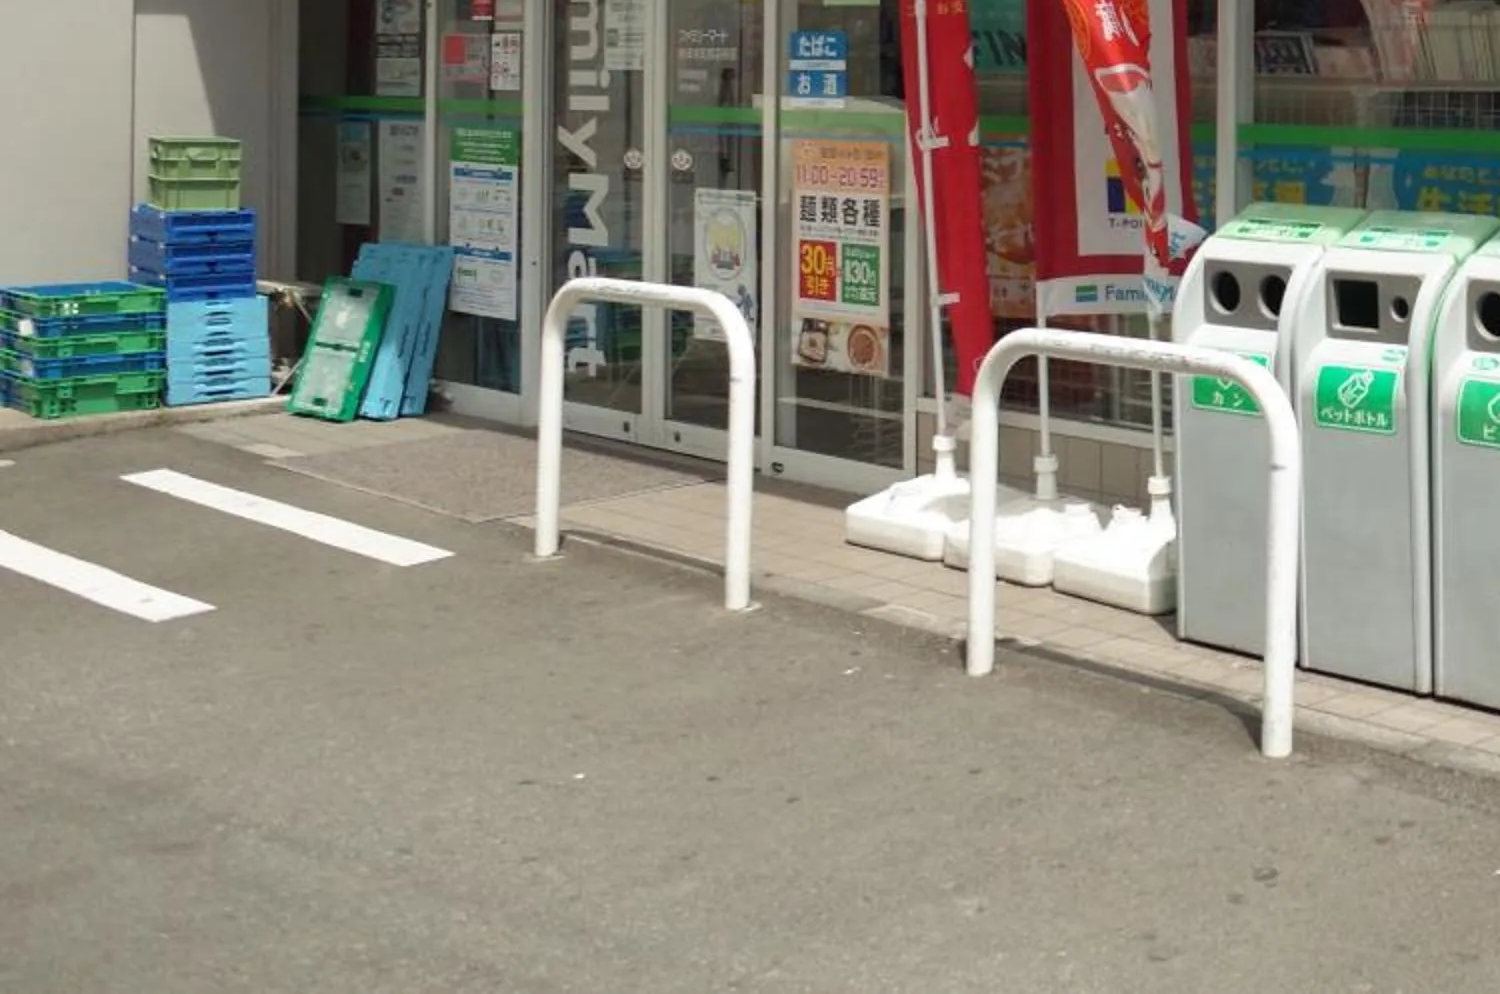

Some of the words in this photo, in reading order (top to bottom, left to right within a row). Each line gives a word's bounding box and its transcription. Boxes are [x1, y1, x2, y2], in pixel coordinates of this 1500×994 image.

[797, 33, 838, 58] たばこ
[1212, 392, 1245, 407] カン
[1320, 408, 1388, 428] ペットボトル
